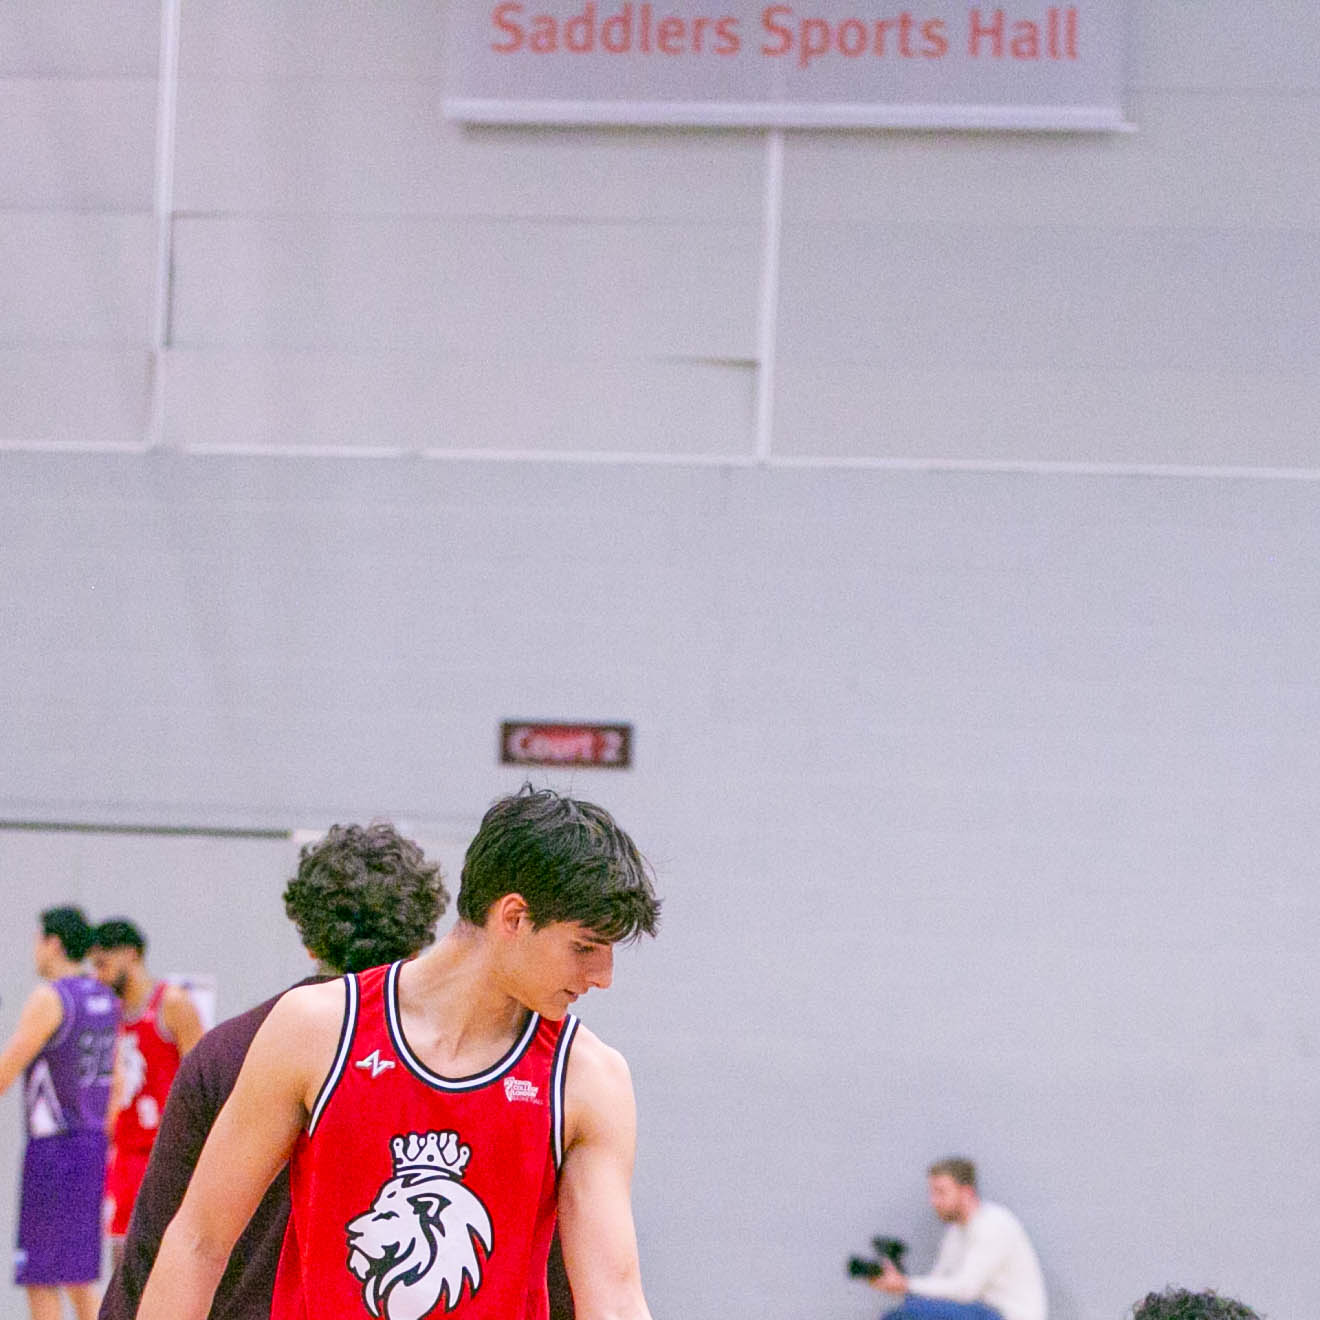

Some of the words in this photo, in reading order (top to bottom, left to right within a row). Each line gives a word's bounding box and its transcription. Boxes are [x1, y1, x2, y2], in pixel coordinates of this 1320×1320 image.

[491, 3, 740, 56] Saddlers
[761, 5, 949, 67] Sports
[968, 8, 1079, 60] Hall
[509, 730, 593, 762] Court
[602, 731, 622, 762] 2
